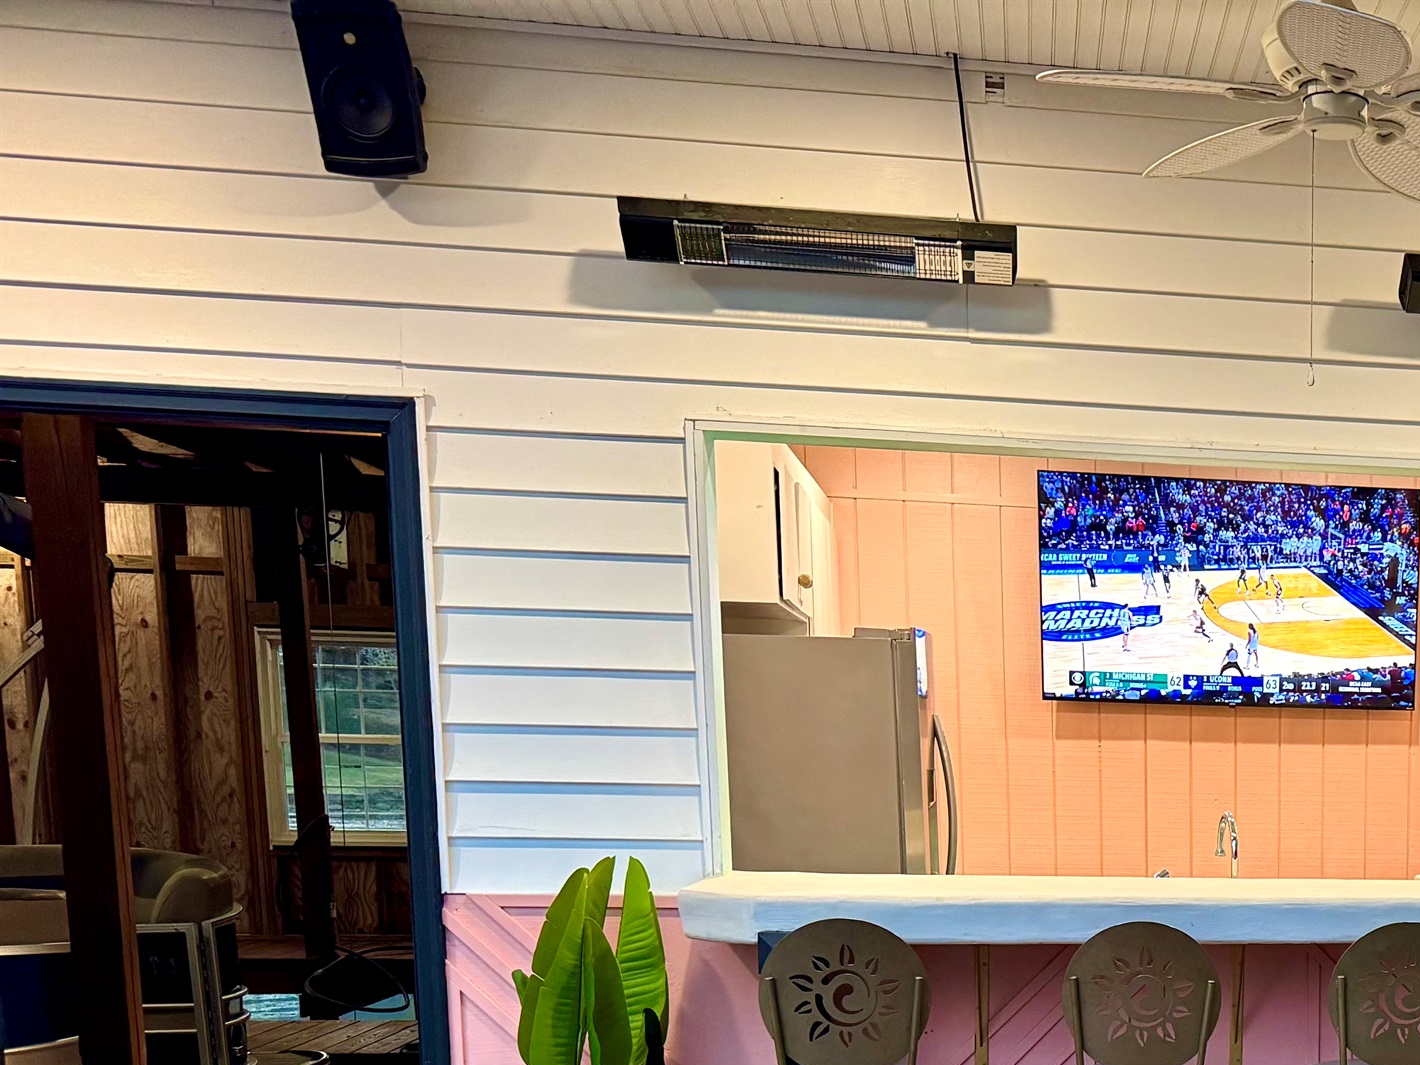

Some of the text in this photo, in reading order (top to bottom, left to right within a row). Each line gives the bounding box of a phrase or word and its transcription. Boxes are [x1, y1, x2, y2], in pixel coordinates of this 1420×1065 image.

[1042, 614, 1161, 631] MADNSS
[1112, 672, 1146, 681] MICHIGAN
[1169, 675, 1182, 687] 62
[1209, 675, 1232, 684] UCONN
[1265, 679, 1277, 690] 63
